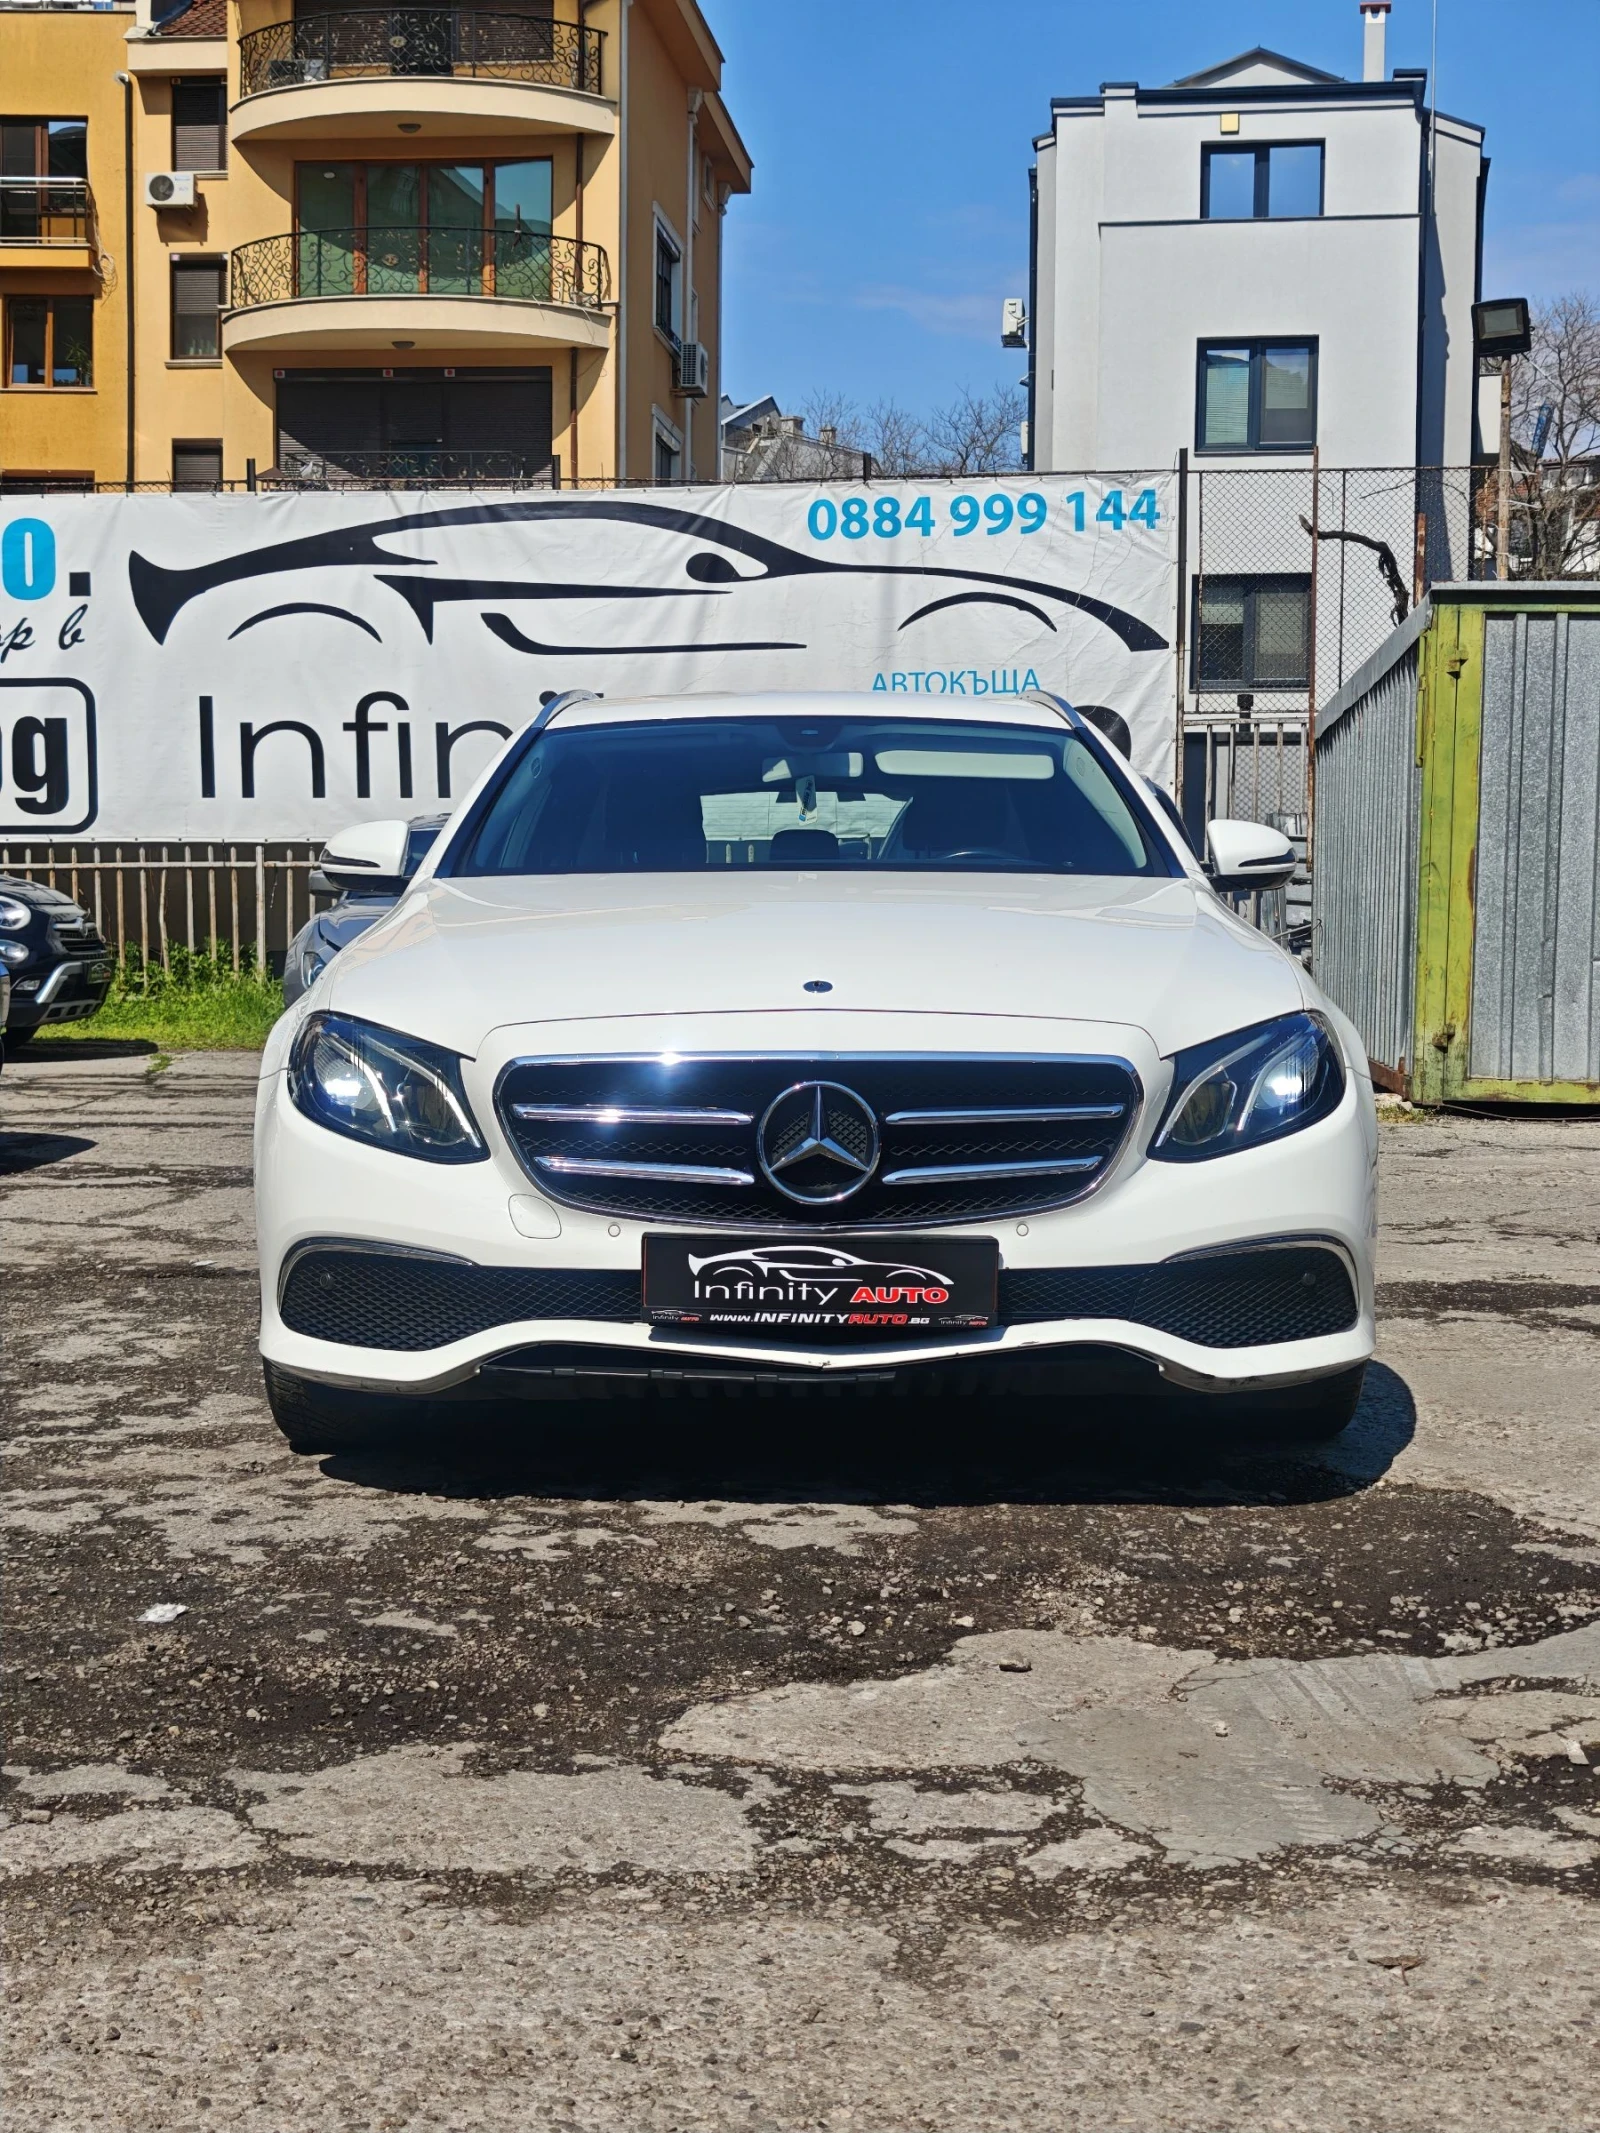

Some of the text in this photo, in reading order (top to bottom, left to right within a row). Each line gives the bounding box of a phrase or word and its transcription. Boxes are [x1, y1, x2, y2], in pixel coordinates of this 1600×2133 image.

[807, 489, 1161, 541] 0884 999 144
[872, 668, 1042, 696] АВТОКЪЩА
[694, 1280, 950, 1306] Infinity AUTO
